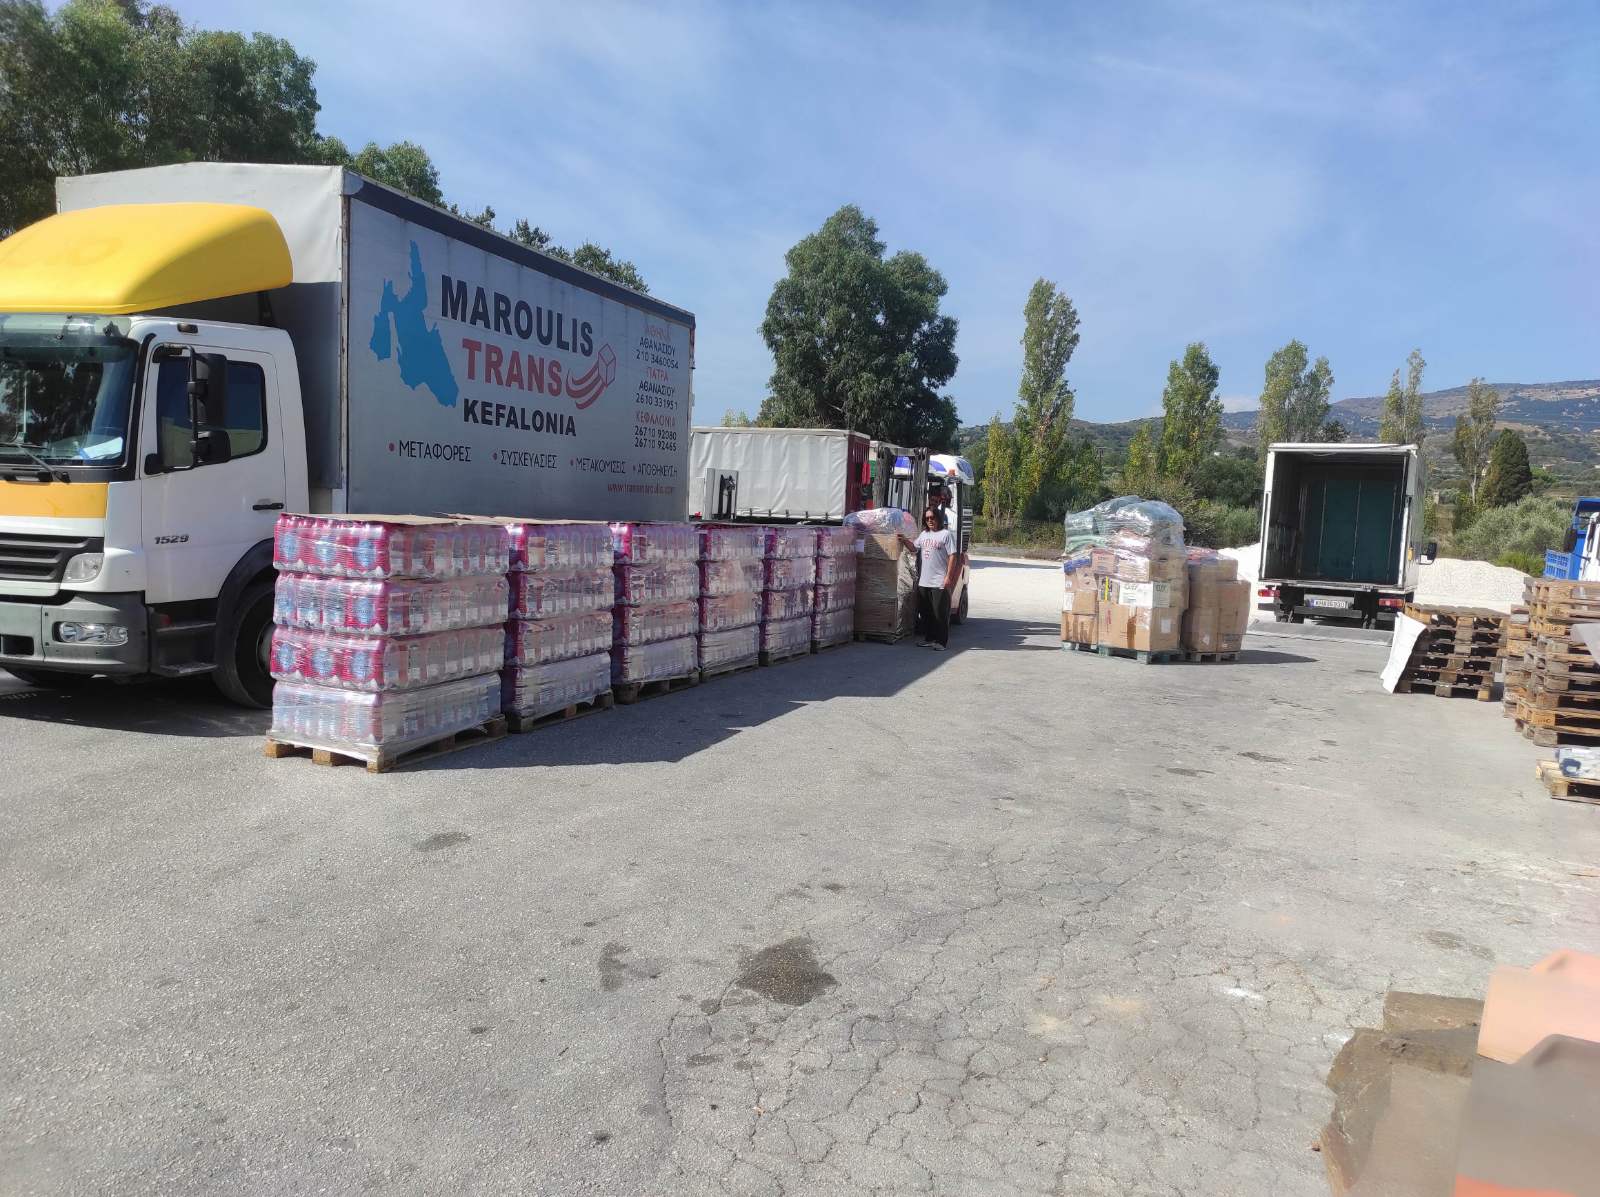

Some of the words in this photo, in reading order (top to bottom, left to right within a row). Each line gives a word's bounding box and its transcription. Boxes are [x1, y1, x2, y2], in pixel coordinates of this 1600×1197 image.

[441, 274, 594, 357] MAROULIS
[636, 349, 649, 361] 210
[462, 337, 563, 397] TRANS
[636, 393, 653, 406] 2610
[654, 396, 678, 410] 331951
[463, 398, 577, 437] KEFALONIA
[399, 439, 472, 463] ΜΕΤΑΦΟΡΕΣ
[500, 450, 558, 469] ΣΥΣΚΕΥΑΣΙΕΣ
[154, 535, 189, 544] 1529
